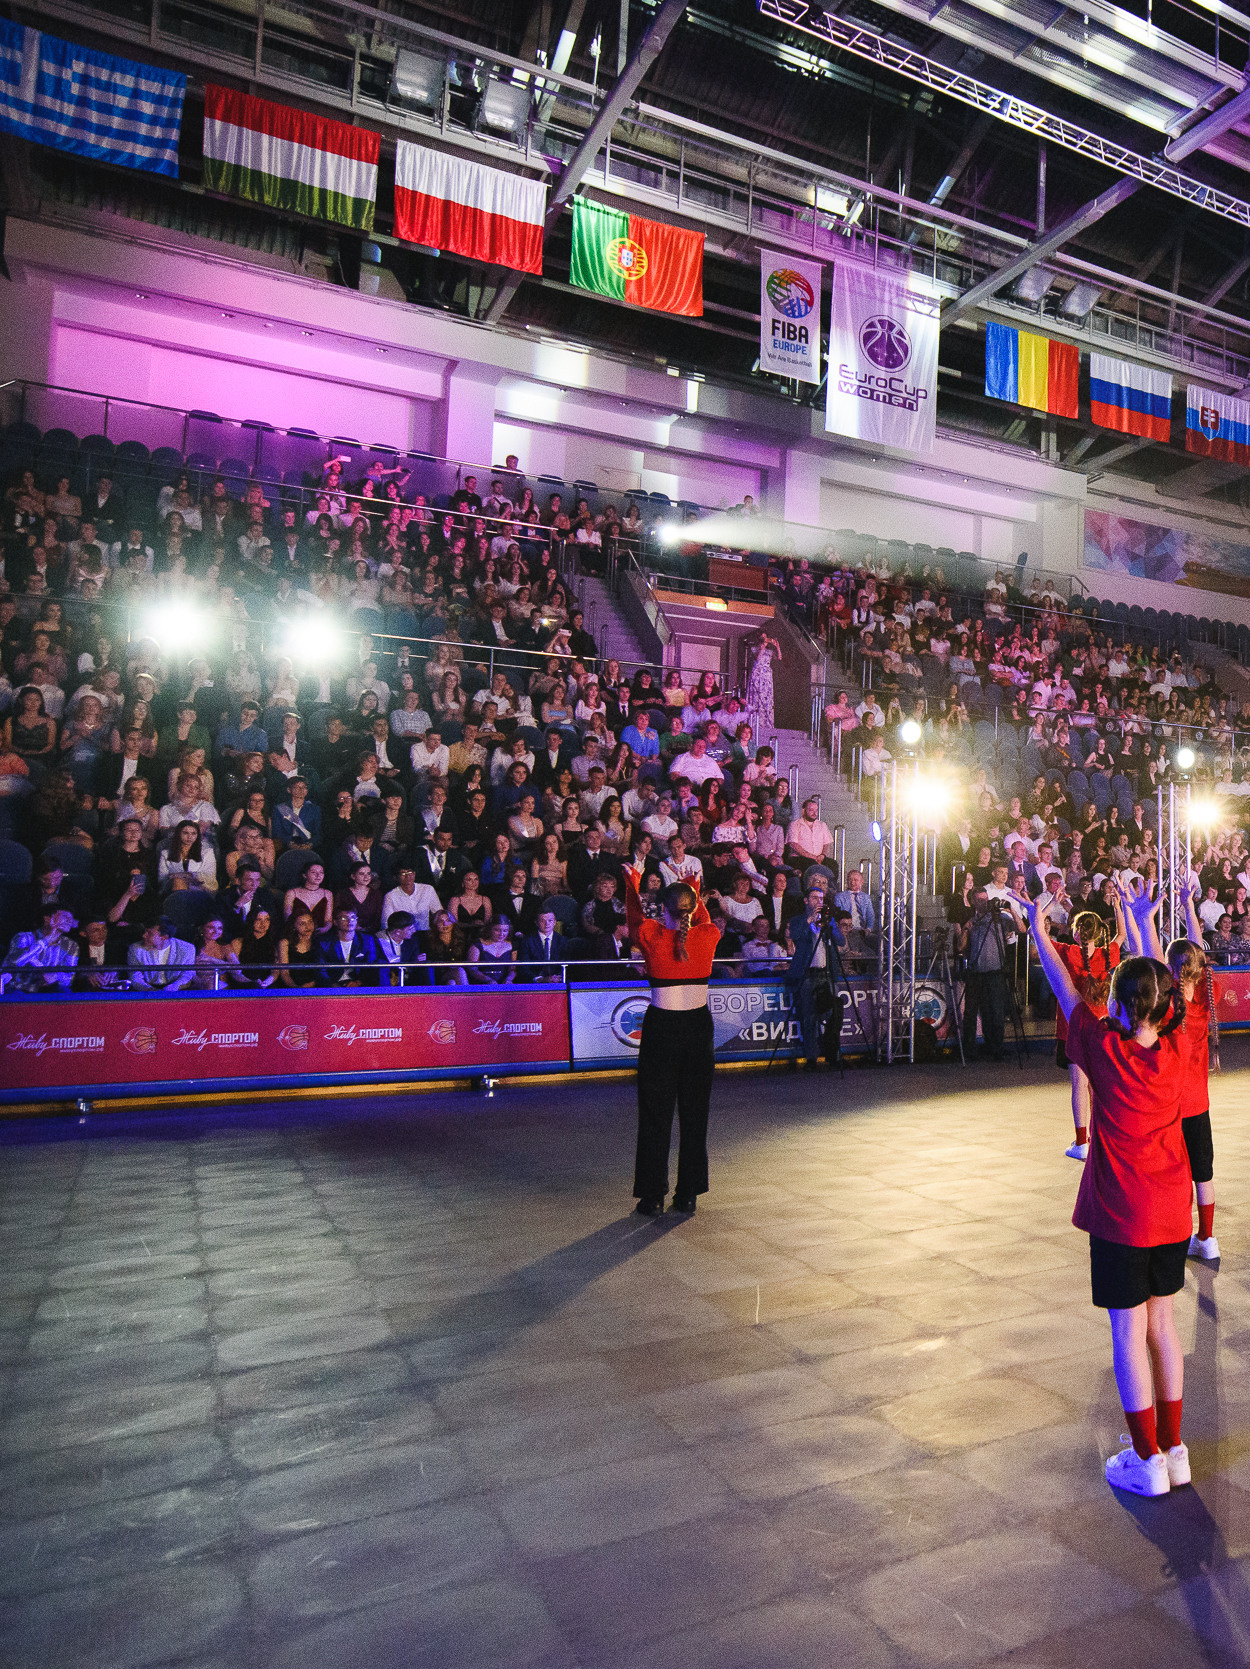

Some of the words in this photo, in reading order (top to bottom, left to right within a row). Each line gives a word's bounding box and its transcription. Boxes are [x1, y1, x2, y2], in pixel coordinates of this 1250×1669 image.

[772, 317, 809, 345] FIBA
[773, 338, 808, 356] EUROPE
[838, 363, 928, 400] EuroCup
[839, 380, 918, 411] women
[709, 991, 796, 1015] ВОРЕЦ
[211, 1032, 259, 1044] СПОРТОМ
[359, 1027, 402, 1039] СПОРТОМ
[503, 1022, 542, 1033] СПОРТОМ
[738, 1018, 865, 1043] «ВИДЕ»
[52, 1036, 105, 1048] СПОРТОМ
